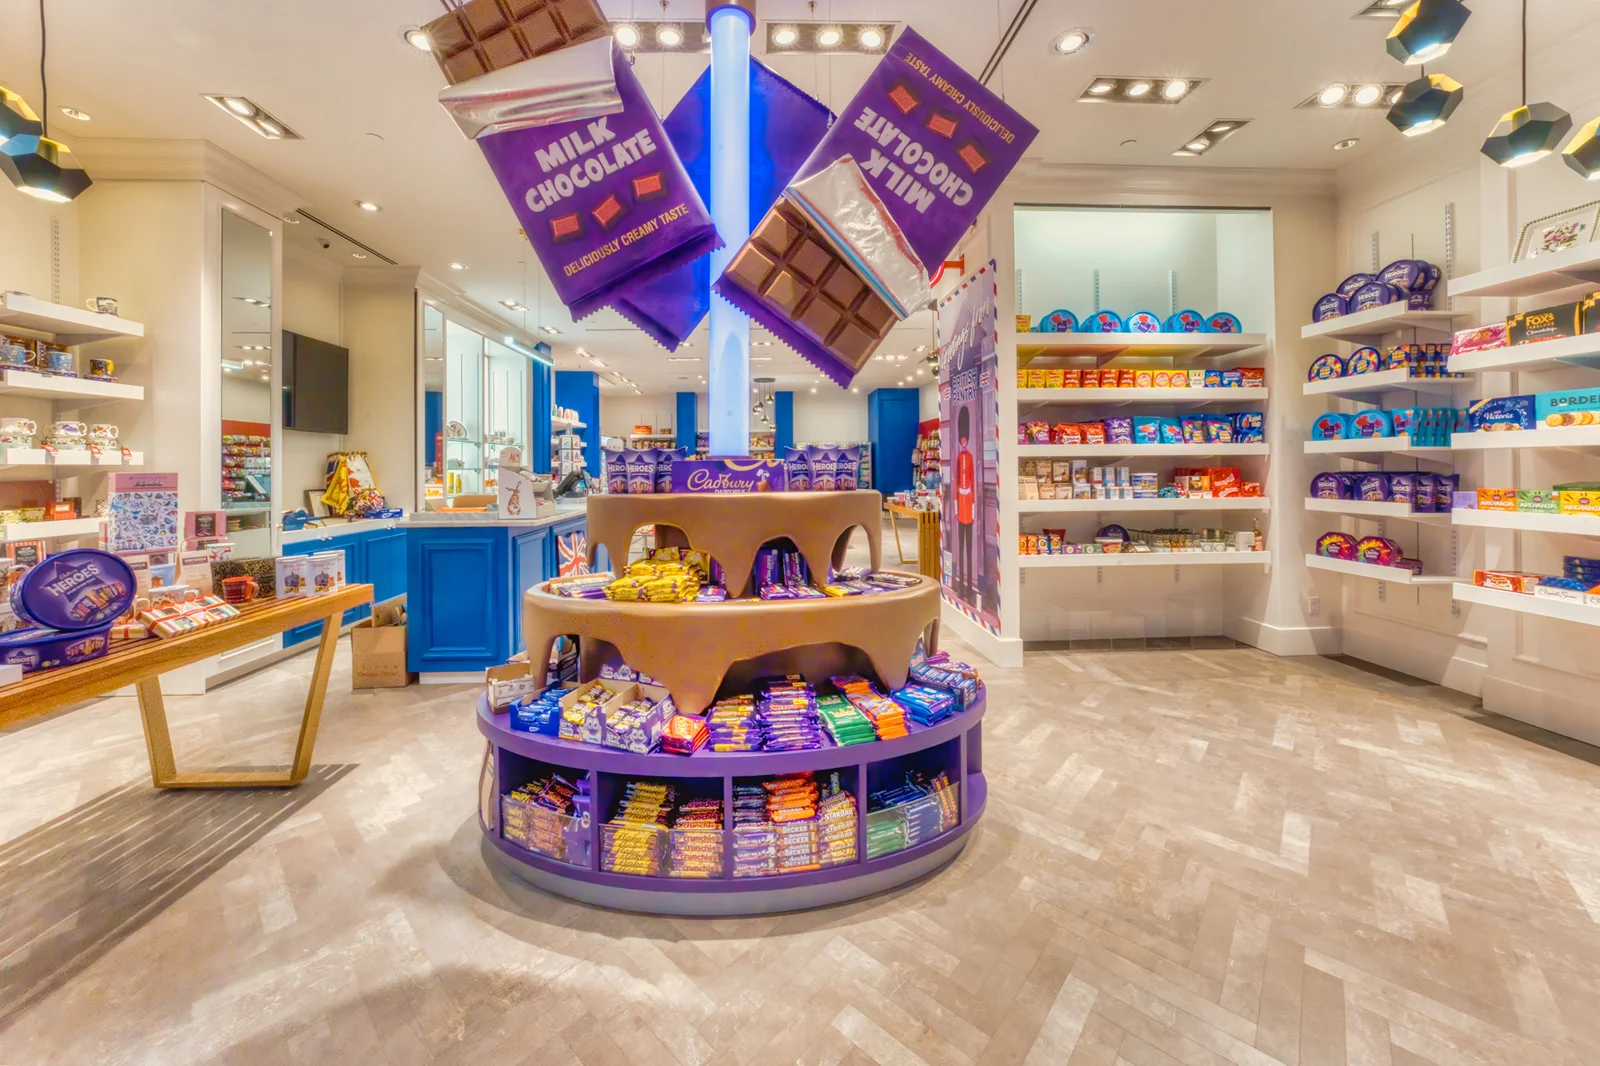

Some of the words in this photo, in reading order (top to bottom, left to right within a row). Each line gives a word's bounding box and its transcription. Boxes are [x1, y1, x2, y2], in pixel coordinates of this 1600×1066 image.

[904, 52, 931, 77] TASTE
[930, 72, 966, 105] CREAMY
[963, 98, 1015, 144] DELICIOUSLY
[534, 115, 616, 173] MILK
[853, 106, 974, 206] CHOCOLATE
[525, 128, 657, 213] CHOCOLATE
[860, 148, 936, 214] MILK
[563, 238, 621, 277] DELICIOUSLY
[620, 218, 660, 246] CREAMY
[658, 203, 689, 226] TASTE
[1385, 267, 1408, 279] HEROES
[952, 366, 979, 390] BRITISH
[952, 385, 978, 405] PANTRY
[1483, 412, 1514, 421] Victoria
[607, 463, 626, 473] HERO
[627, 463, 654, 473] HEROES
[789, 462, 808, 471] HERO
[812, 462, 837, 472] HEROES
[687, 468, 754, 493] Cadbury
[46, 563, 100, 597] HEROES
[685, 813, 718, 821] crunchie
[825, 808, 854, 820] STARBAR
[825, 821, 854, 833] STARBAR
[682, 834, 718, 843] crunchie
[784, 837, 810, 845] DECKER
[684, 844, 717, 853] crunchie
[784, 848, 810, 857] DECKER
[680, 853, 713, 862] crunchie
[683, 865, 716, 873] crunchie
